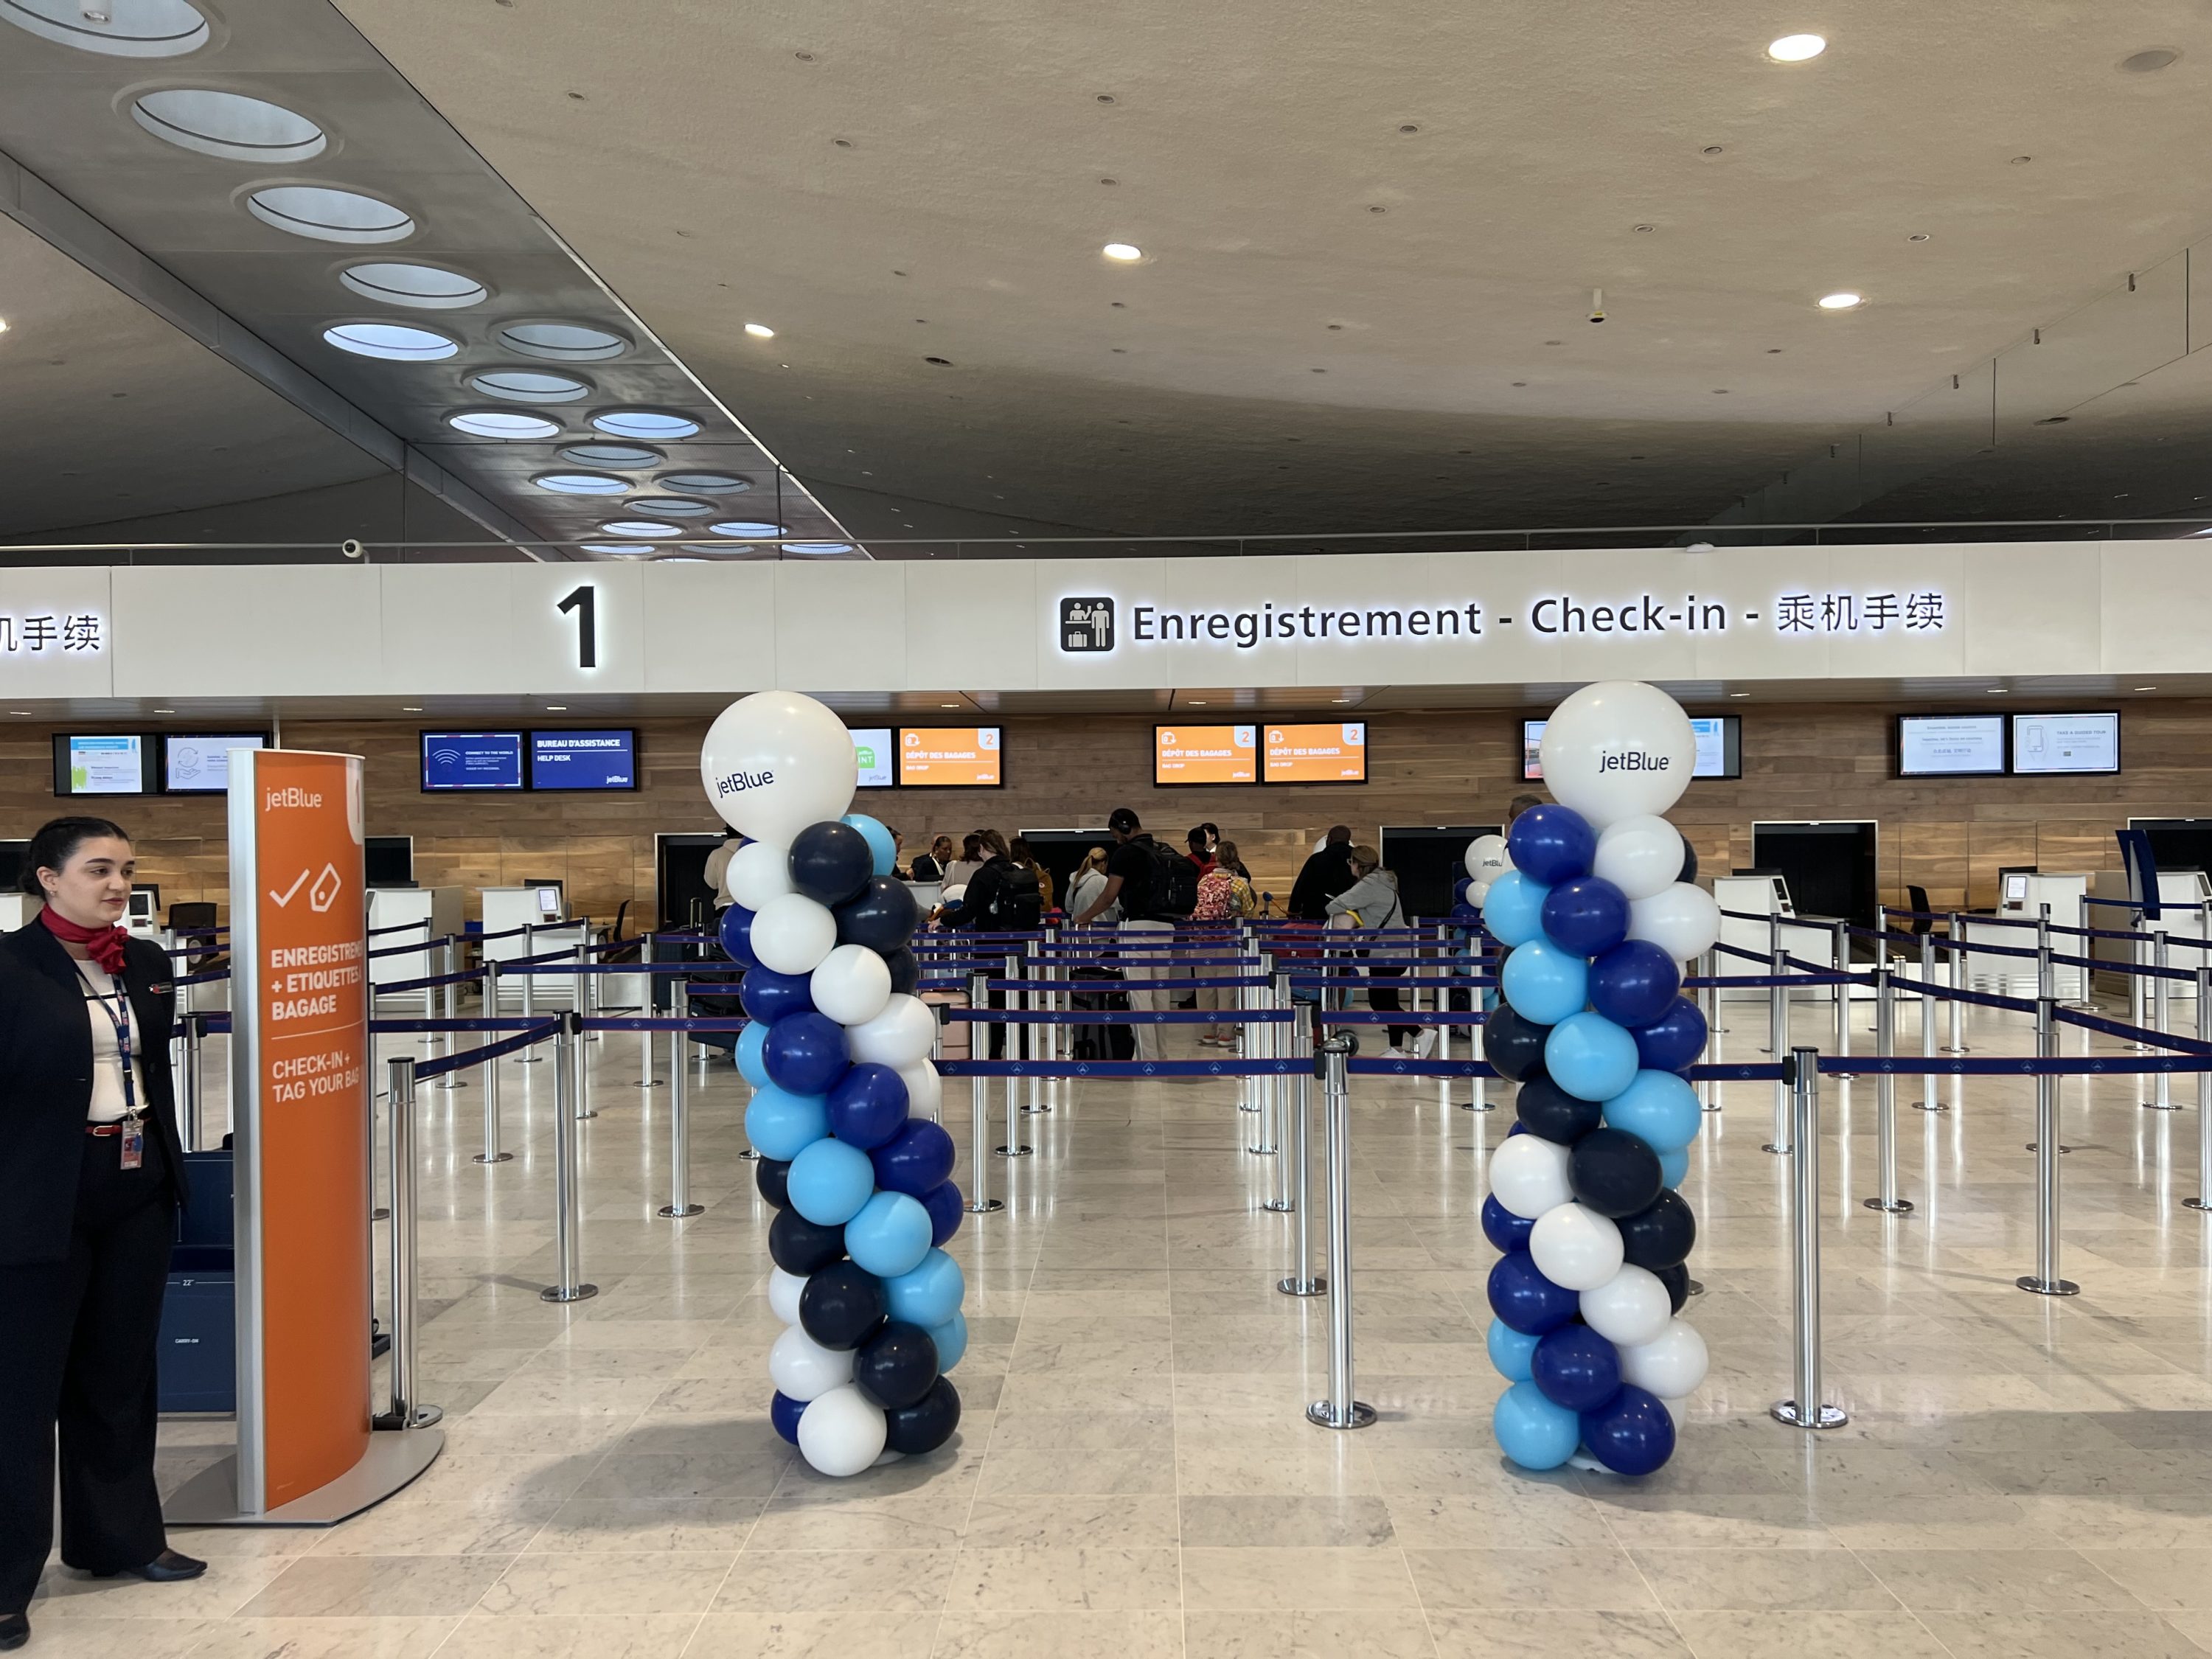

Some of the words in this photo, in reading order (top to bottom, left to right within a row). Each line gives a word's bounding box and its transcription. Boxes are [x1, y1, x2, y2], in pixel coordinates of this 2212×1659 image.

[1133, 602, 1481, 647] Enregistrement
[1531, 595, 1726, 633] Check-in
[1777, 592, 1944, 631] 乘机手续
[557, 586, 596, 667] 1
[986, 734, 993, 745] 2
[1242, 731, 1250, 742] 2
[1350, 728, 1358, 740] 2
[537, 740, 567, 748] BUREAU
[568, 739, 621, 747] D'ASSISTANCE
[905, 751, 928, 759] DÉPÔT
[1162, 748, 1184, 757] DÉPÔT
[1270, 747, 1292, 756] DÉPÔT
[1599, 750, 1669, 773] jetBlue
[606, 776, 628, 785] jetBlue
[715, 771, 774, 799] jetBlue
[265, 787, 322, 812] jetBlue
[1482, 858, 1503, 867] jetBlu
[272, 995, 337, 1020] BAGAGE
[272, 1050, 343, 1079] CHECK-IN
[272, 1081, 306, 1103] TAG
[308, 1073, 344, 1096] YOUR
[345, 1067, 359, 1088] BAG
